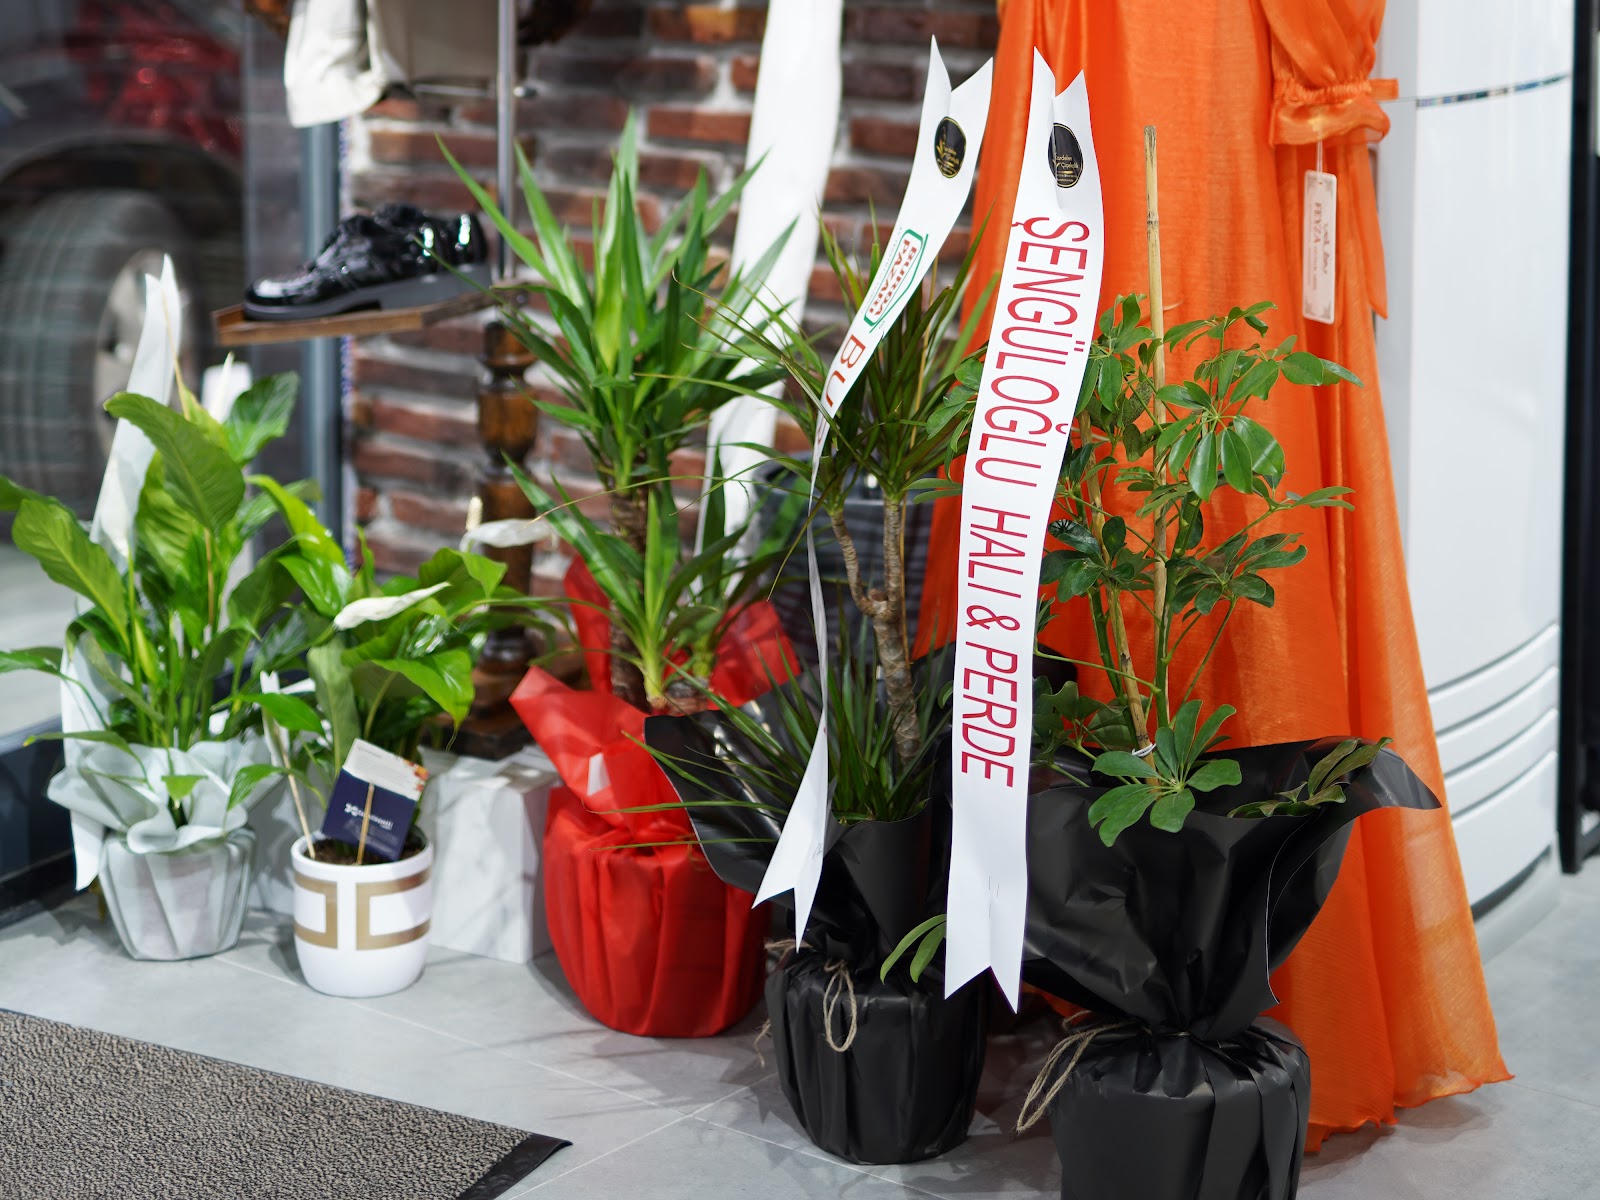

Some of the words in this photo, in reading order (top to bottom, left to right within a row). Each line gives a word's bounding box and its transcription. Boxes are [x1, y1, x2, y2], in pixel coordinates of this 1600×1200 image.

[869, 239, 911, 314] PAZARI
[975, 216, 1090, 488] ŞENGÜLOĞLU
[967, 505, 1031, 599] HALI
[965, 605, 1021, 632] &
[961, 641, 1018, 788] PERDE
